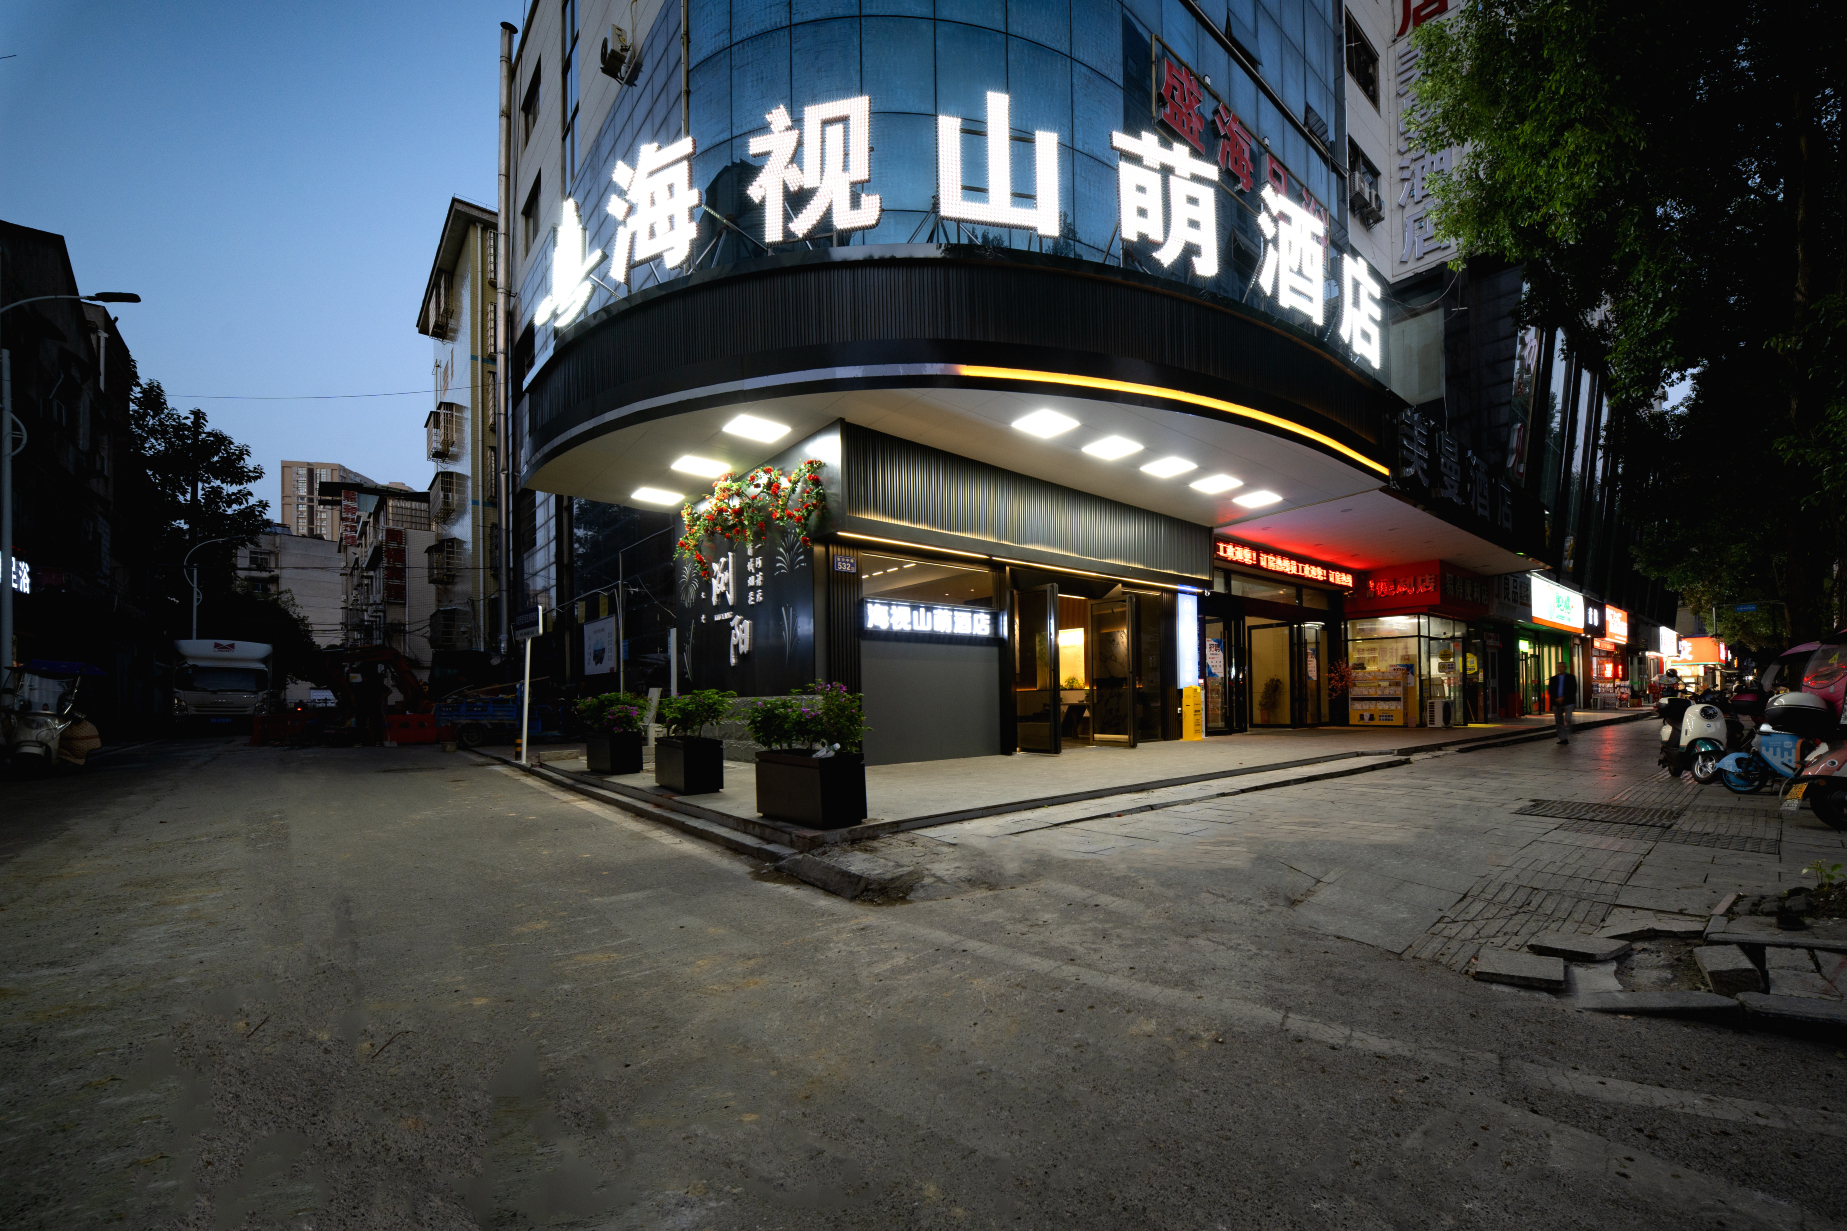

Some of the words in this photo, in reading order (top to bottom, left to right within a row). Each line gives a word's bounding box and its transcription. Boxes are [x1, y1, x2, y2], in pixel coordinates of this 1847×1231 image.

[606, 91, 1383, 370] 海视山萌酒店
